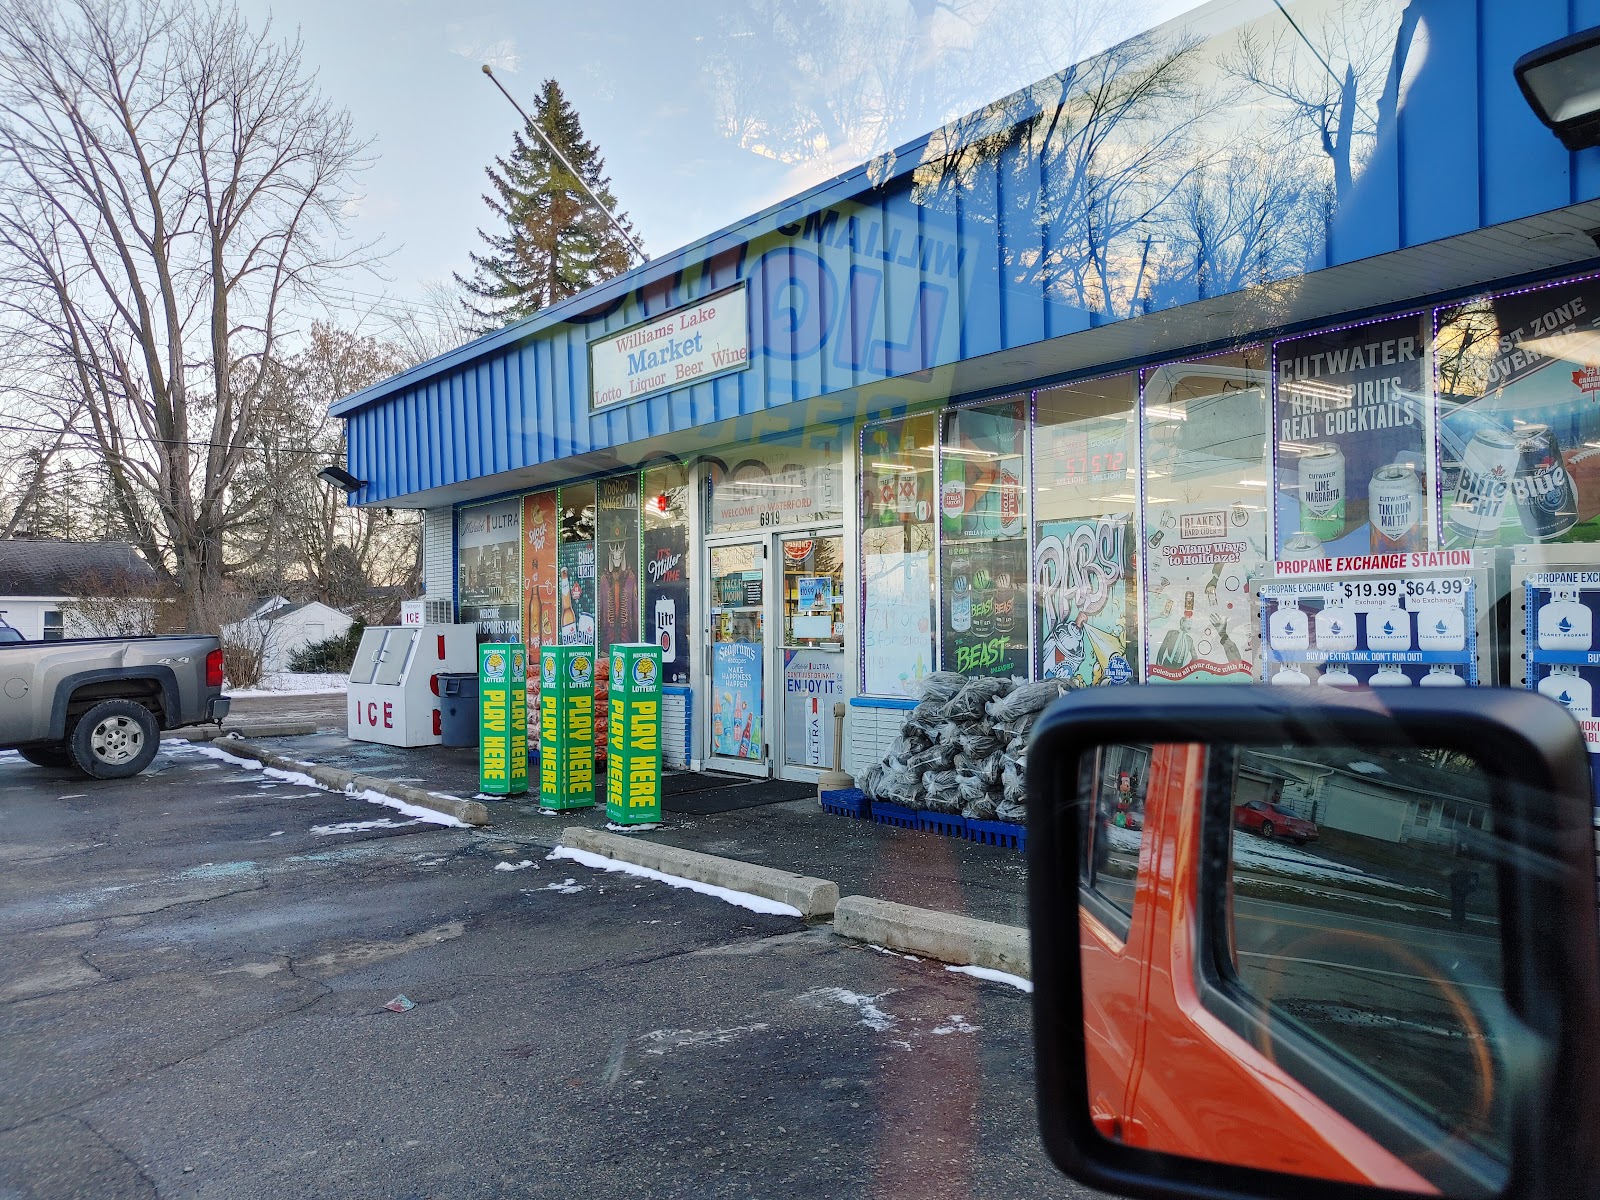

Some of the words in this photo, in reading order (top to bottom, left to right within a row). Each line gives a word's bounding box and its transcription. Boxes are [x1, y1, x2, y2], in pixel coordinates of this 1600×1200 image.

[1530, 297, 1587, 338] ZONE
[616, 323, 674, 353] Williams
[679, 307, 716, 330] Lake
[627, 331, 703, 376] Market
[1280, 337, 1416, 383] CUTWATER
[595, 388, 622, 405] Lotto
[629, 373, 666, 395] Liquor
[675, 360, 704, 380] Beer
[711, 347, 747, 368] Wine
[1291, 392, 1330, 417] REAL
[1336, 376, 1402, 410] SPIRITS
[1281, 415, 1319, 441] REAL
[1325, 400, 1414, 436] COCKTAILS
[1091, 453, 1125, 474] 572
[1308, 470, 1336, 479] CUTWATER
[1460, 466, 1508, 499] Blue
[1513, 466, 1565, 500] Blue
[603, 480, 629, 495] VOODOO
[1314, 480, 1330, 491] LIME
[600, 497, 624, 512] RANGER
[624, 492, 637, 508] IPA
[1305, 489, 1340, 503] MARGARITA
[1379, 493, 1409, 502] CUTWATER
[1455, 489, 1502, 518] LIGHT
[721, 505, 755, 519] WELCOME
[756, 504, 765, 513] TO
[767, 498, 812, 512] WATERFORD
[1378, 503, 1393, 516] TIKI
[1395, 501, 1411, 514] RUM
[491, 514, 520, 531] ULTRA
[760, 511, 780, 527] 6919
[1184, 514, 1222, 528] BLAKE'S
[1381, 516, 1395, 526] MAI
[1397, 515, 1408, 526] TAI
[528, 523, 547, 543] SHOCK
[1184, 529, 1199, 537] HARD
[533, 537, 546, 551] TOP
[1163, 545, 1178, 556] So
[1178, 544, 1212, 555] Many
[1213, 541, 1247, 555] Ways
[578, 552, 595, 565] Blue
[657, 548, 671, 560] IT'S
[1169, 555, 1182, 566] to
[1182, 552, 1241, 565] Holidaze!
[1276, 558, 1333, 574] PROPANE
[1336, 554, 1407, 572] EXCHANGE
[1412, 550, 1471, 568] STATION
[578, 566, 595, 578] LIGHT
[648, 553, 682, 583] Miller
[662, 569, 681, 582] TIME
[1537, 572, 1578, 583] PROPANE
[1268, 584, 1297, 593] PROPANE
[1298, 582, 1334, 593] EXCHANGE
[1344, 582, 1397, 599] $19.99
[1406, 580, 1463, 597] $64.99
[971, 597, 993, 618] BEAST
[994, 597, 1014, 616] BEAST
[1421, 596, 1456, 604] Exchange
[405, 612, 420, 624] ICE
[479, 608, 500, 620] WELCOME
[657, 611, 674, 629] Lite
[482, 620, 505, 635] SPORTS
[505, 619, 520, 634] FANS
[866, 630, 875, 647] 3
[877, 630, 898, 648] for
[719, 643, 756, 661] Seagram's
[954, 635, 1010, 674] BEAST
[1306, 652, 1319, 661] BUY
[1320, 652, 1328, 661] AN
[1329, 652, 1350, 661] EXTRA
[1351, 652, 1370, 661] TANK.
[1371, 652, 1392, 662] DON'T
[1393, 652, 1407, 661] RUN
[1408, 652, 1423, 662] OUT!
[722, 673, 752, 681] HAPPINESS
[728, 666, 744, 674] MAKE
[1152, 667, 1182, 678] celebrate
[1182, 667, 1190, 676] all
[1190, 663, 1205, 672] your
[1205, 663, 1221, 673] daze
[1222, 663, 1237, 673] with
[632, 685, 657, 693] LOTTERY
[725, 680, 748, 688] HAPPEN
[787, 679, 822, 694] ENJOY
[825, 679, 835, 694] IT
[357, 699, 393, 729] ICE
[484, 690, 506, 732] PLAY
[511, 689, 525, 731] PLAY
[542, 696, 556, 742] PLAY
[568, 696, 592, 741] PLAY
[610, 699, 625, 750] PLAY
[630, 701, 657, 751] PLAY
[484, 736, 505, 780] HERE
[511, 735, 526, 779] HERE
[542, 747, 556, 794] HERE
[569, 746, 592, 794] HERE
[608, 754, 623, 807] HERE
[629, 755, 657, 808] HERE
